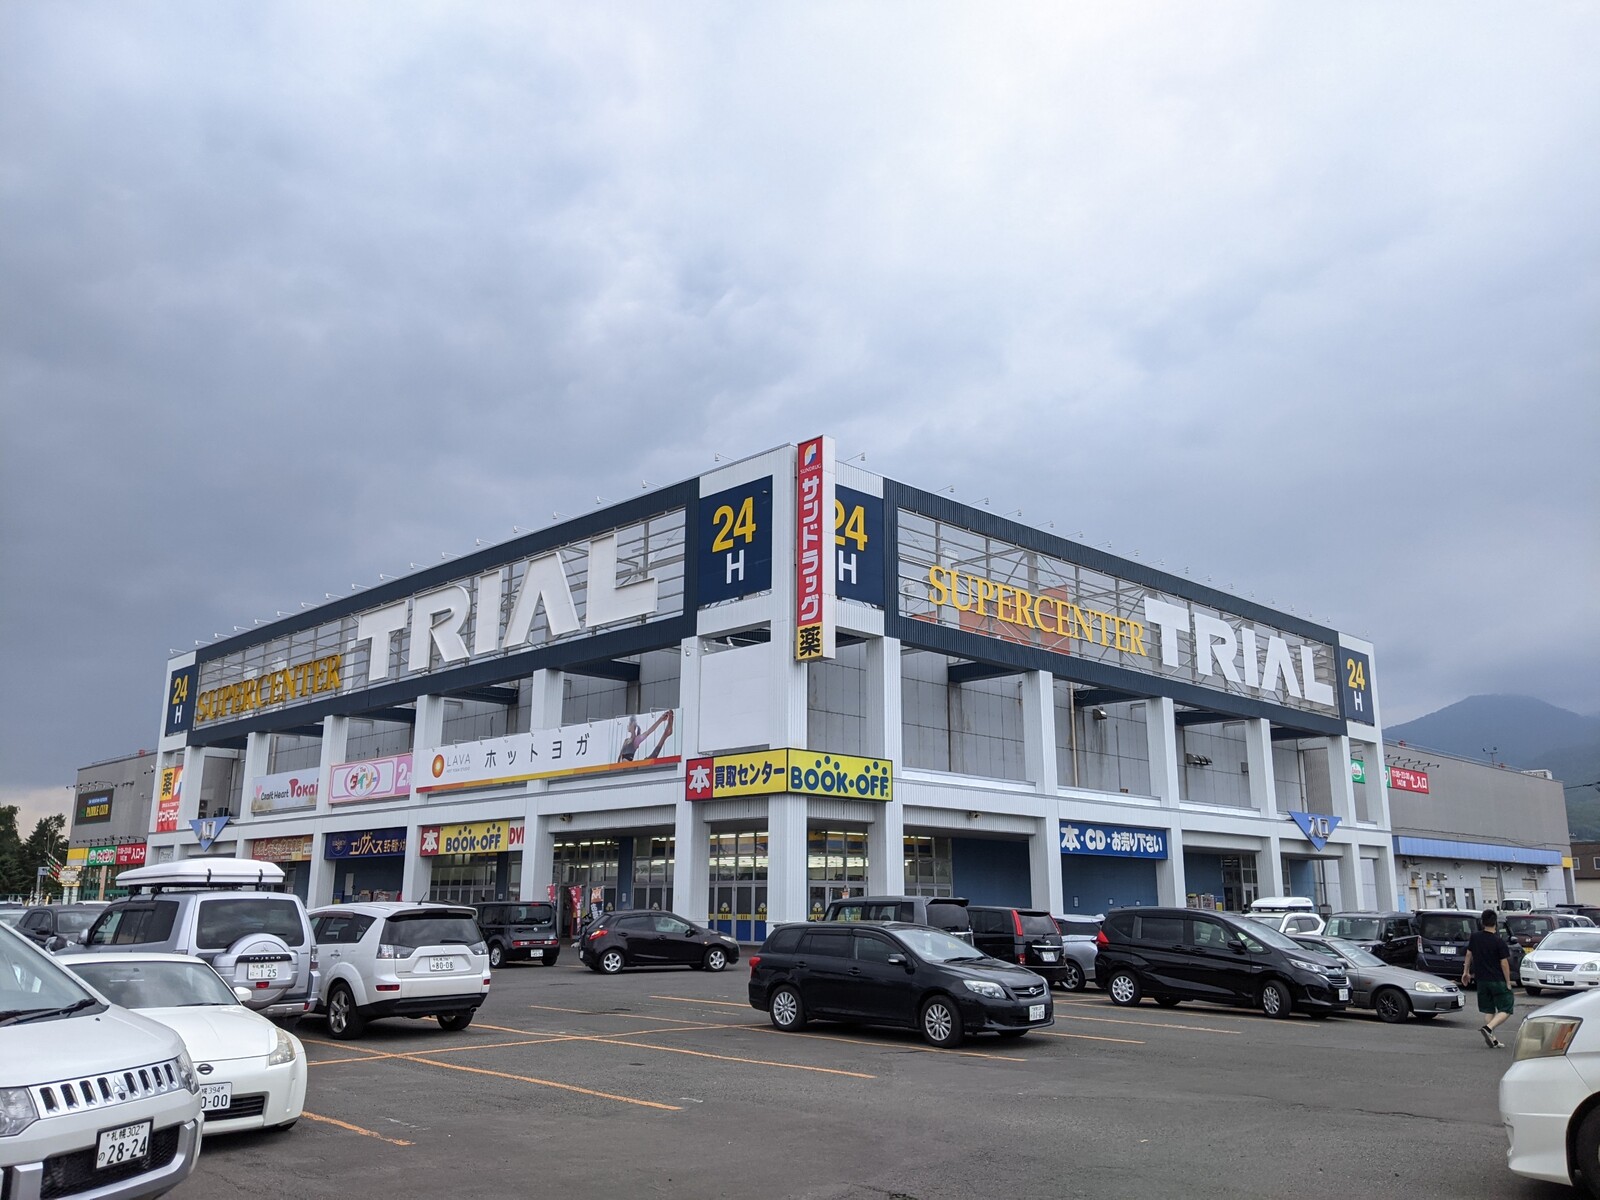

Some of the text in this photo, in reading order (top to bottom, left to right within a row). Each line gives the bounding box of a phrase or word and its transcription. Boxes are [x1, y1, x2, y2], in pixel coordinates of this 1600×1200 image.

[800, 463, 822, 475] SUNDRUG
[712, 496, 756, 553] 24
[800, 475, 822, 623] サンドラッグ
[726, 549, 744, 584] H
[838, 550, 857, 585] H
[358, 532, 659, 682] TRIAL
[800, 626, 821, 657] 薬
[927, 565, 1334, 706] SUPERCENTER TRIAL
[172, 675, 188, 705] 24
[196, 654, 342, 722] SUPERCENTER
[1346, 658, 1365, 691] 24
[175, 704, 182, 724] H
[1354, 691, 1363, 712] H
[447, 753, 471, 767] LAVA
[484, 733, 590, 768] ホットヨガ
[289, 778, 319, 798] Tokai
[689, 760, 785, 794] 本 買取センター
[422, 829, 438, 852] 本
[107, 1136, 147, 1165] 28-24
